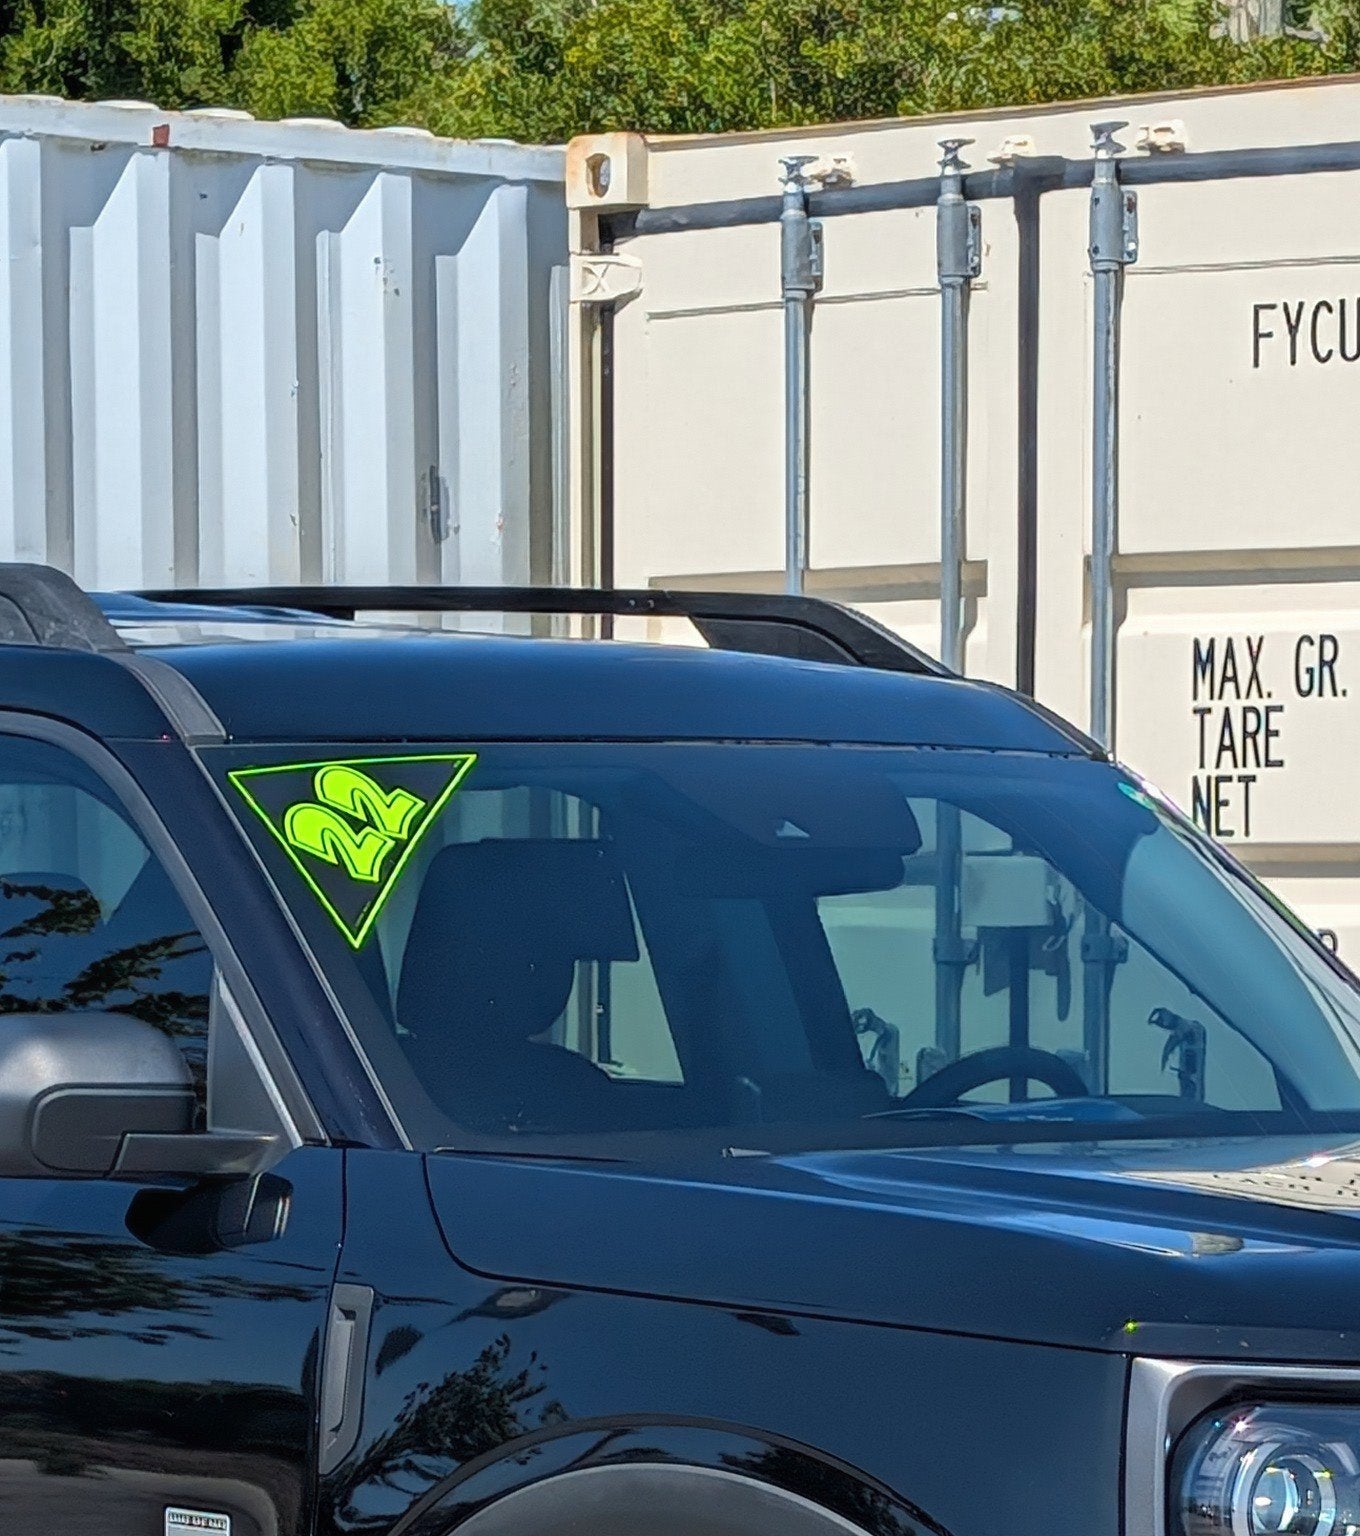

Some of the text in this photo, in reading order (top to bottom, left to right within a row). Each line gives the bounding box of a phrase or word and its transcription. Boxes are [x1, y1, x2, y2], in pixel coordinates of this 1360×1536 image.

[1192, 634, 1273, 702] MAX.
[1294, 633, 1348, 699] GR.
[1192, 704, 1285, 770] TARE
[283, 764, 427, 883] 22
[1191, 774, 1257, 838] NET
